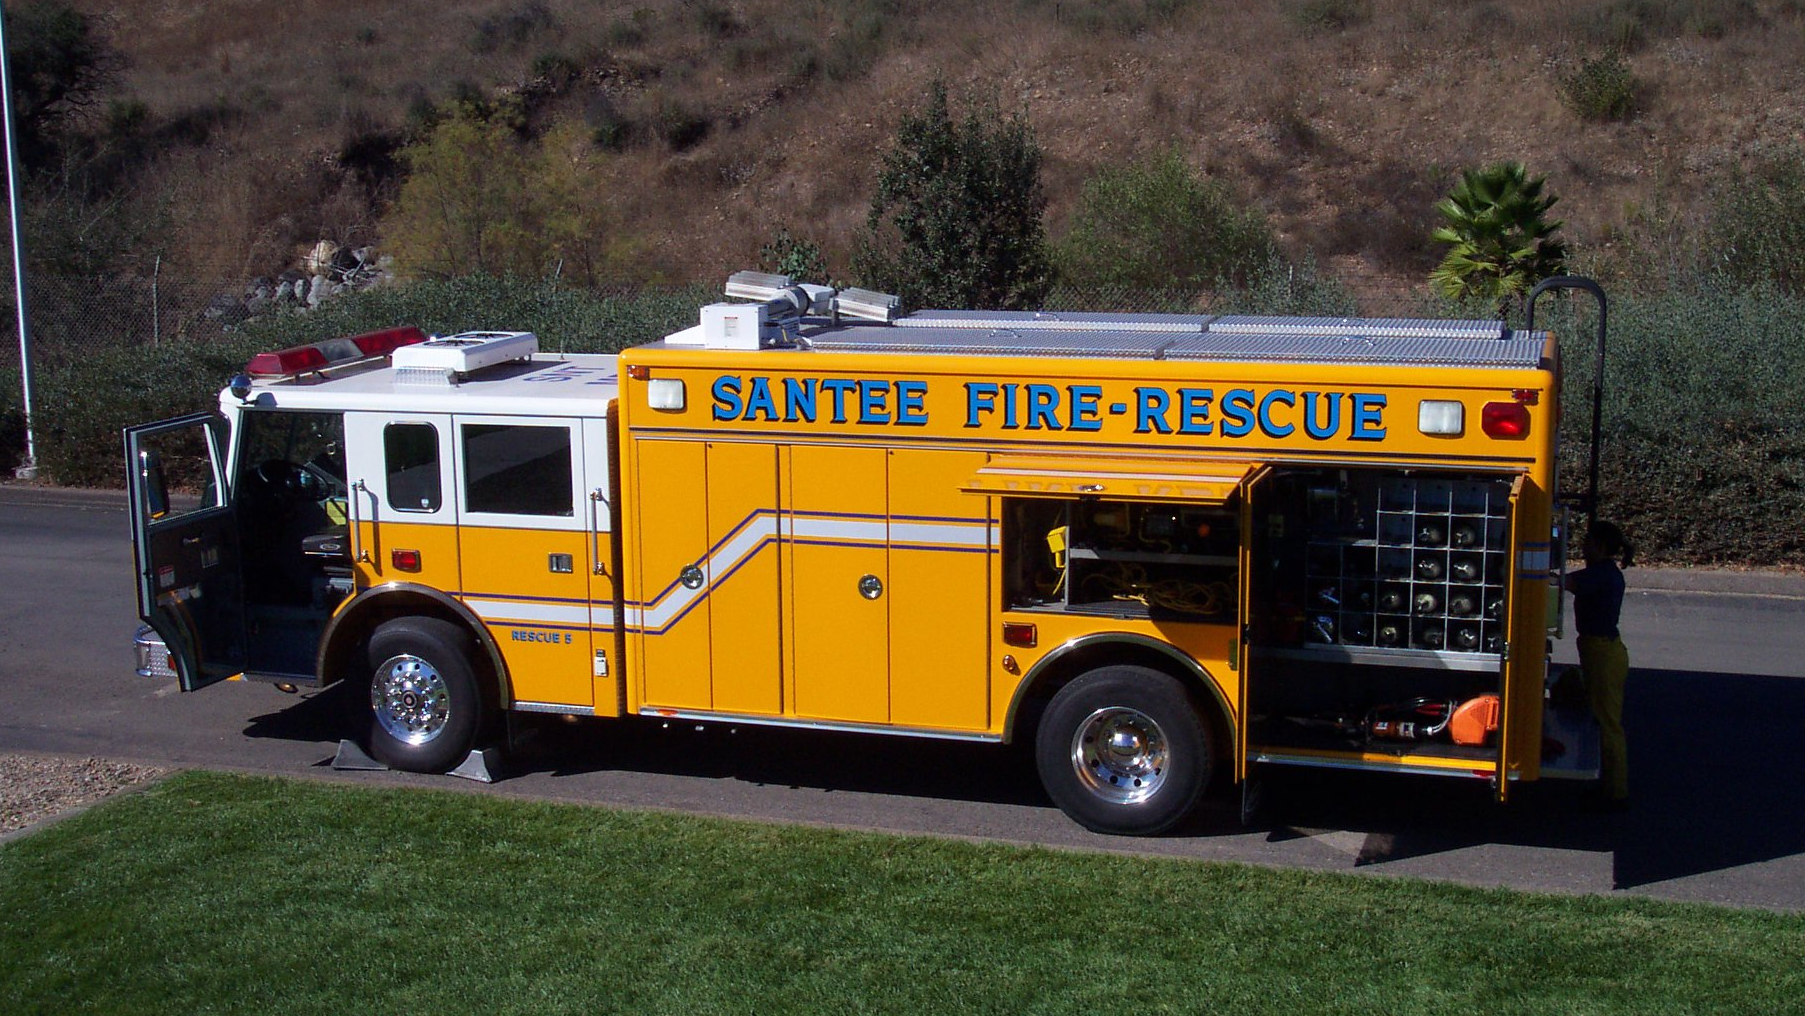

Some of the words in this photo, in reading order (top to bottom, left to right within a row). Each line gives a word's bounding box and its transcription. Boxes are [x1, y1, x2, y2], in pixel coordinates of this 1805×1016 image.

[711, 375, 929, 426] SANTEE
[963, 382, 1387, 442] FIRE-RESCUE
[512, 631, 560, 643] RESCUE
